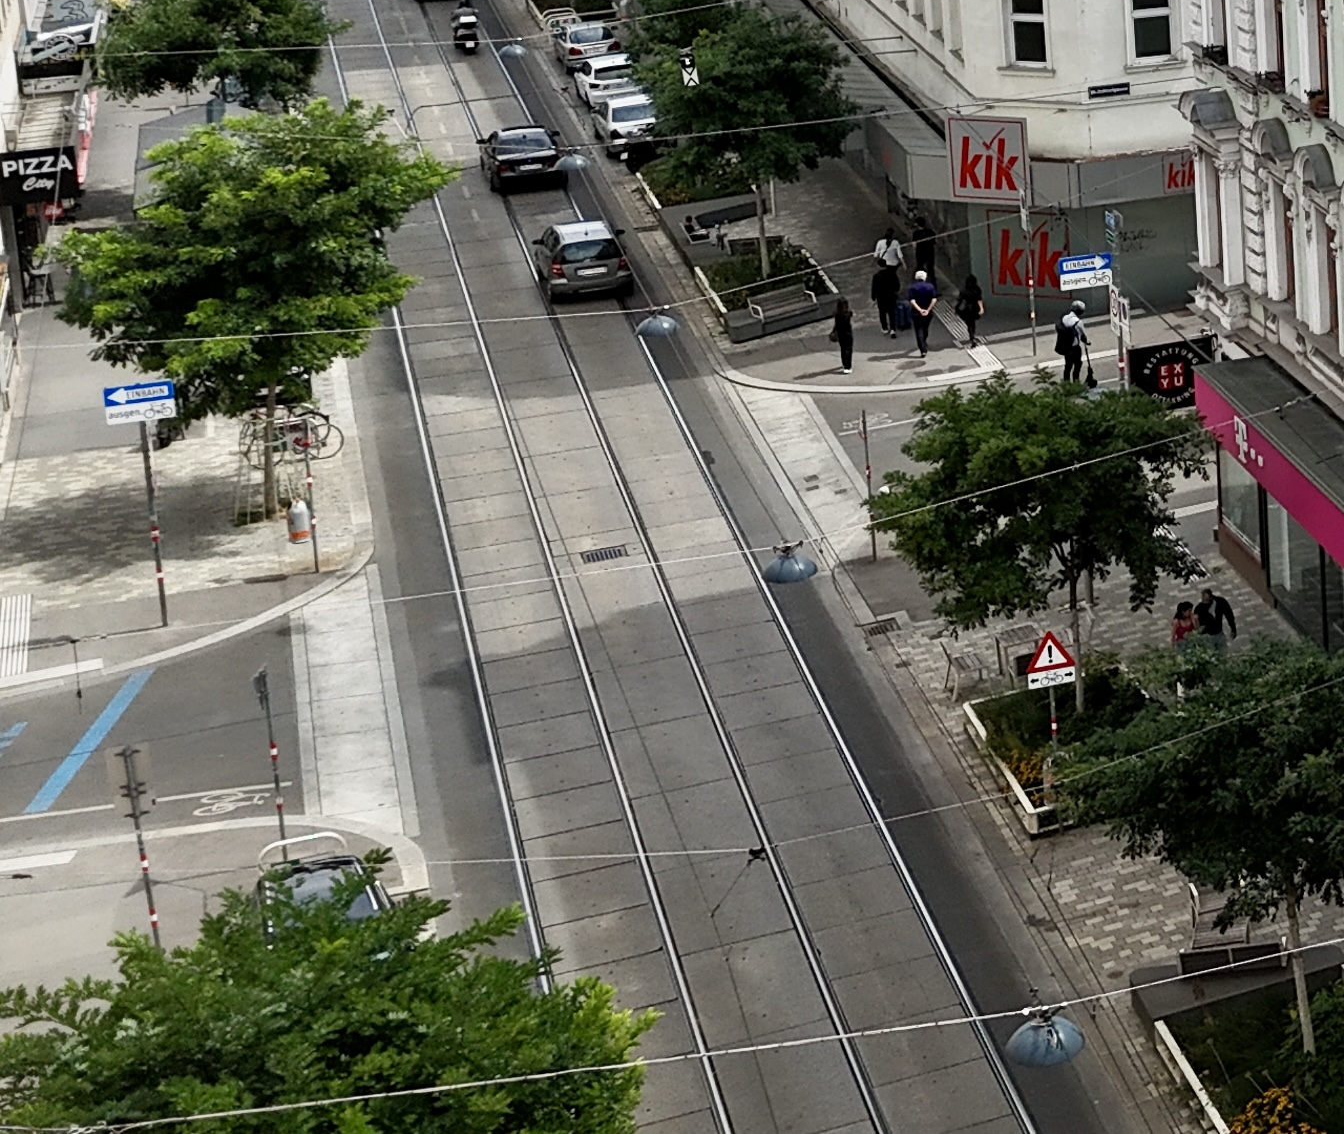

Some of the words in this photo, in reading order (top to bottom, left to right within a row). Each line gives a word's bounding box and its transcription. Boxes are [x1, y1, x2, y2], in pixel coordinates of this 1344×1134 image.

[2, 154, 74, 178] PIZZA
[22, 176, 56, 192] City
[1143, 347, 1199, 374] BESTATTUNG
[126, 387, 166, 399] EINBAHN
